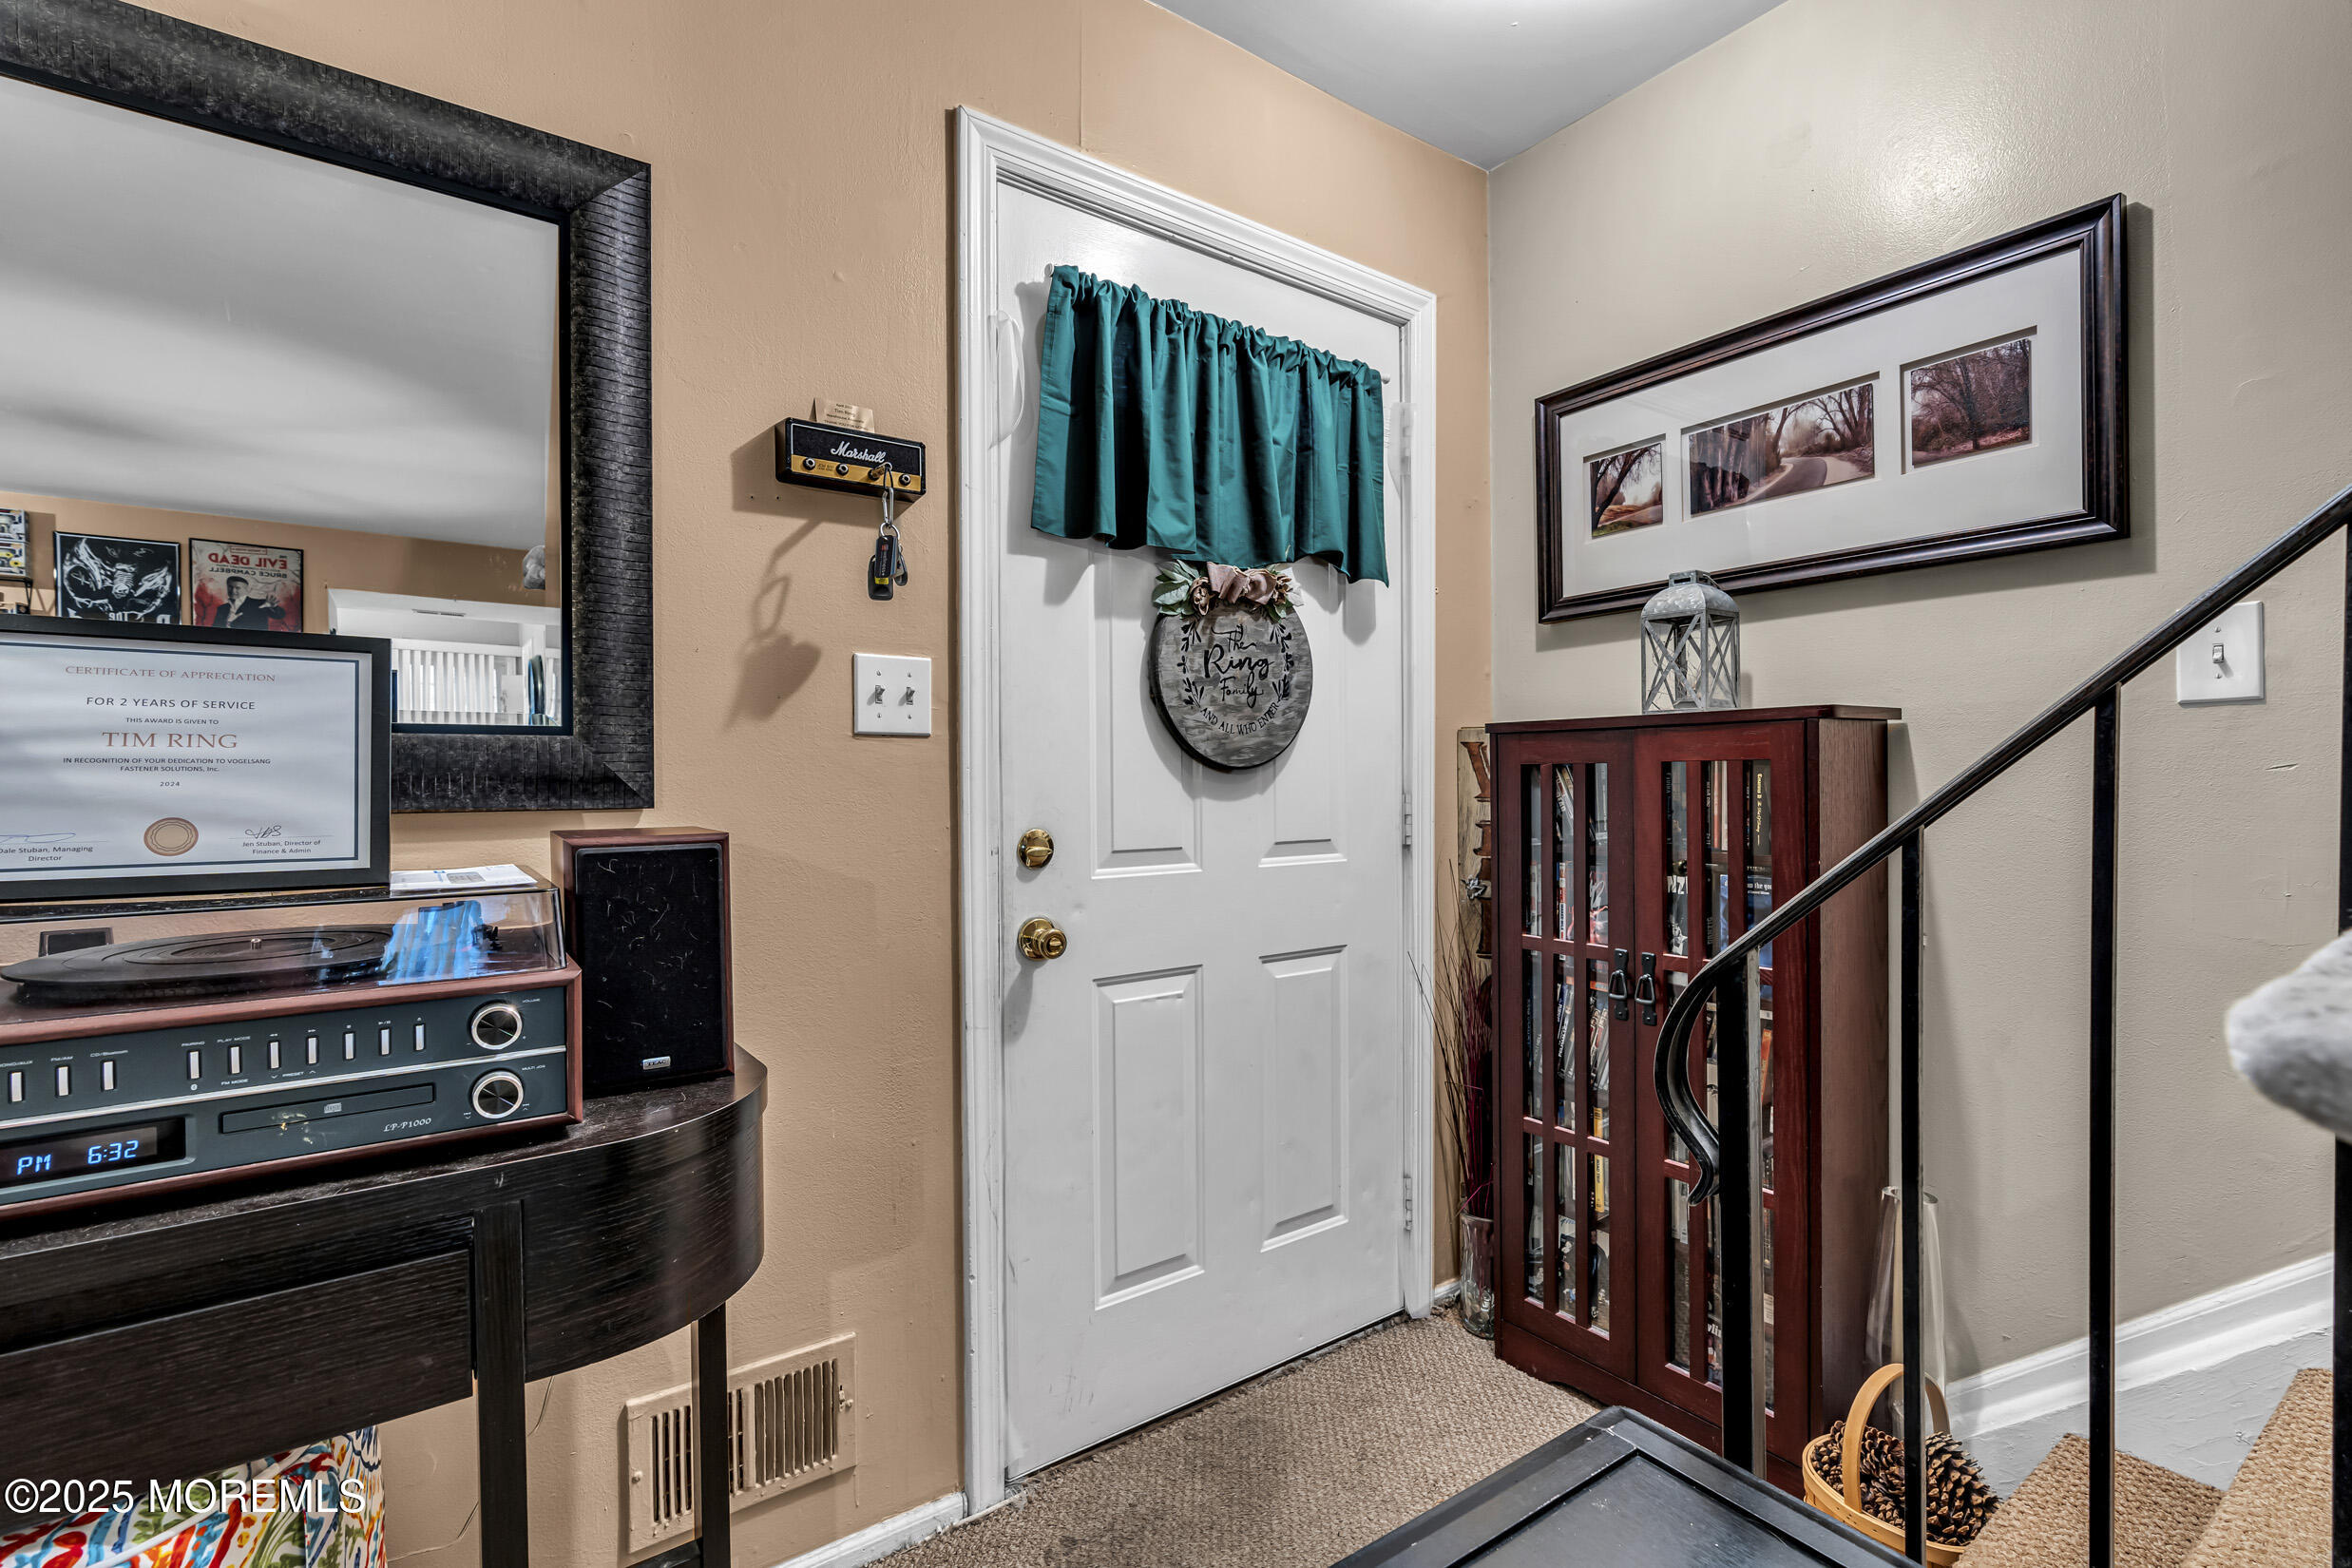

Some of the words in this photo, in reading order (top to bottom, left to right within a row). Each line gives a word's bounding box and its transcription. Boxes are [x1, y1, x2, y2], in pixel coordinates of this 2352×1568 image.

[831, 441, 887, 463] Marshall
[1203, 643, 1274, 680] Ring
[65, 665, 156, 678] CERTIFICATE
[159, 669, 176, 678] OF
[181, 671, 277, 682] APPRECIATION
[86, 697, 115, 706] FOR
[120, 698, 127, 706] 2
[133, 698, 177, 708] YEARS
[181, 699, 199, 709] OF
[202, 700, 256, 710] SERVICE
[1200, 707, 1218, 725] AND
[1218, 721, 1235, 735] ALL
[102, 732, 158, 748] TIM
[166, 733, 239, 749] RING
[383, 1118, 432, 1133] LP-P1000
[17, 1154, 51, 1176] PM
[87, 1140, 139, 1165] 6:32
